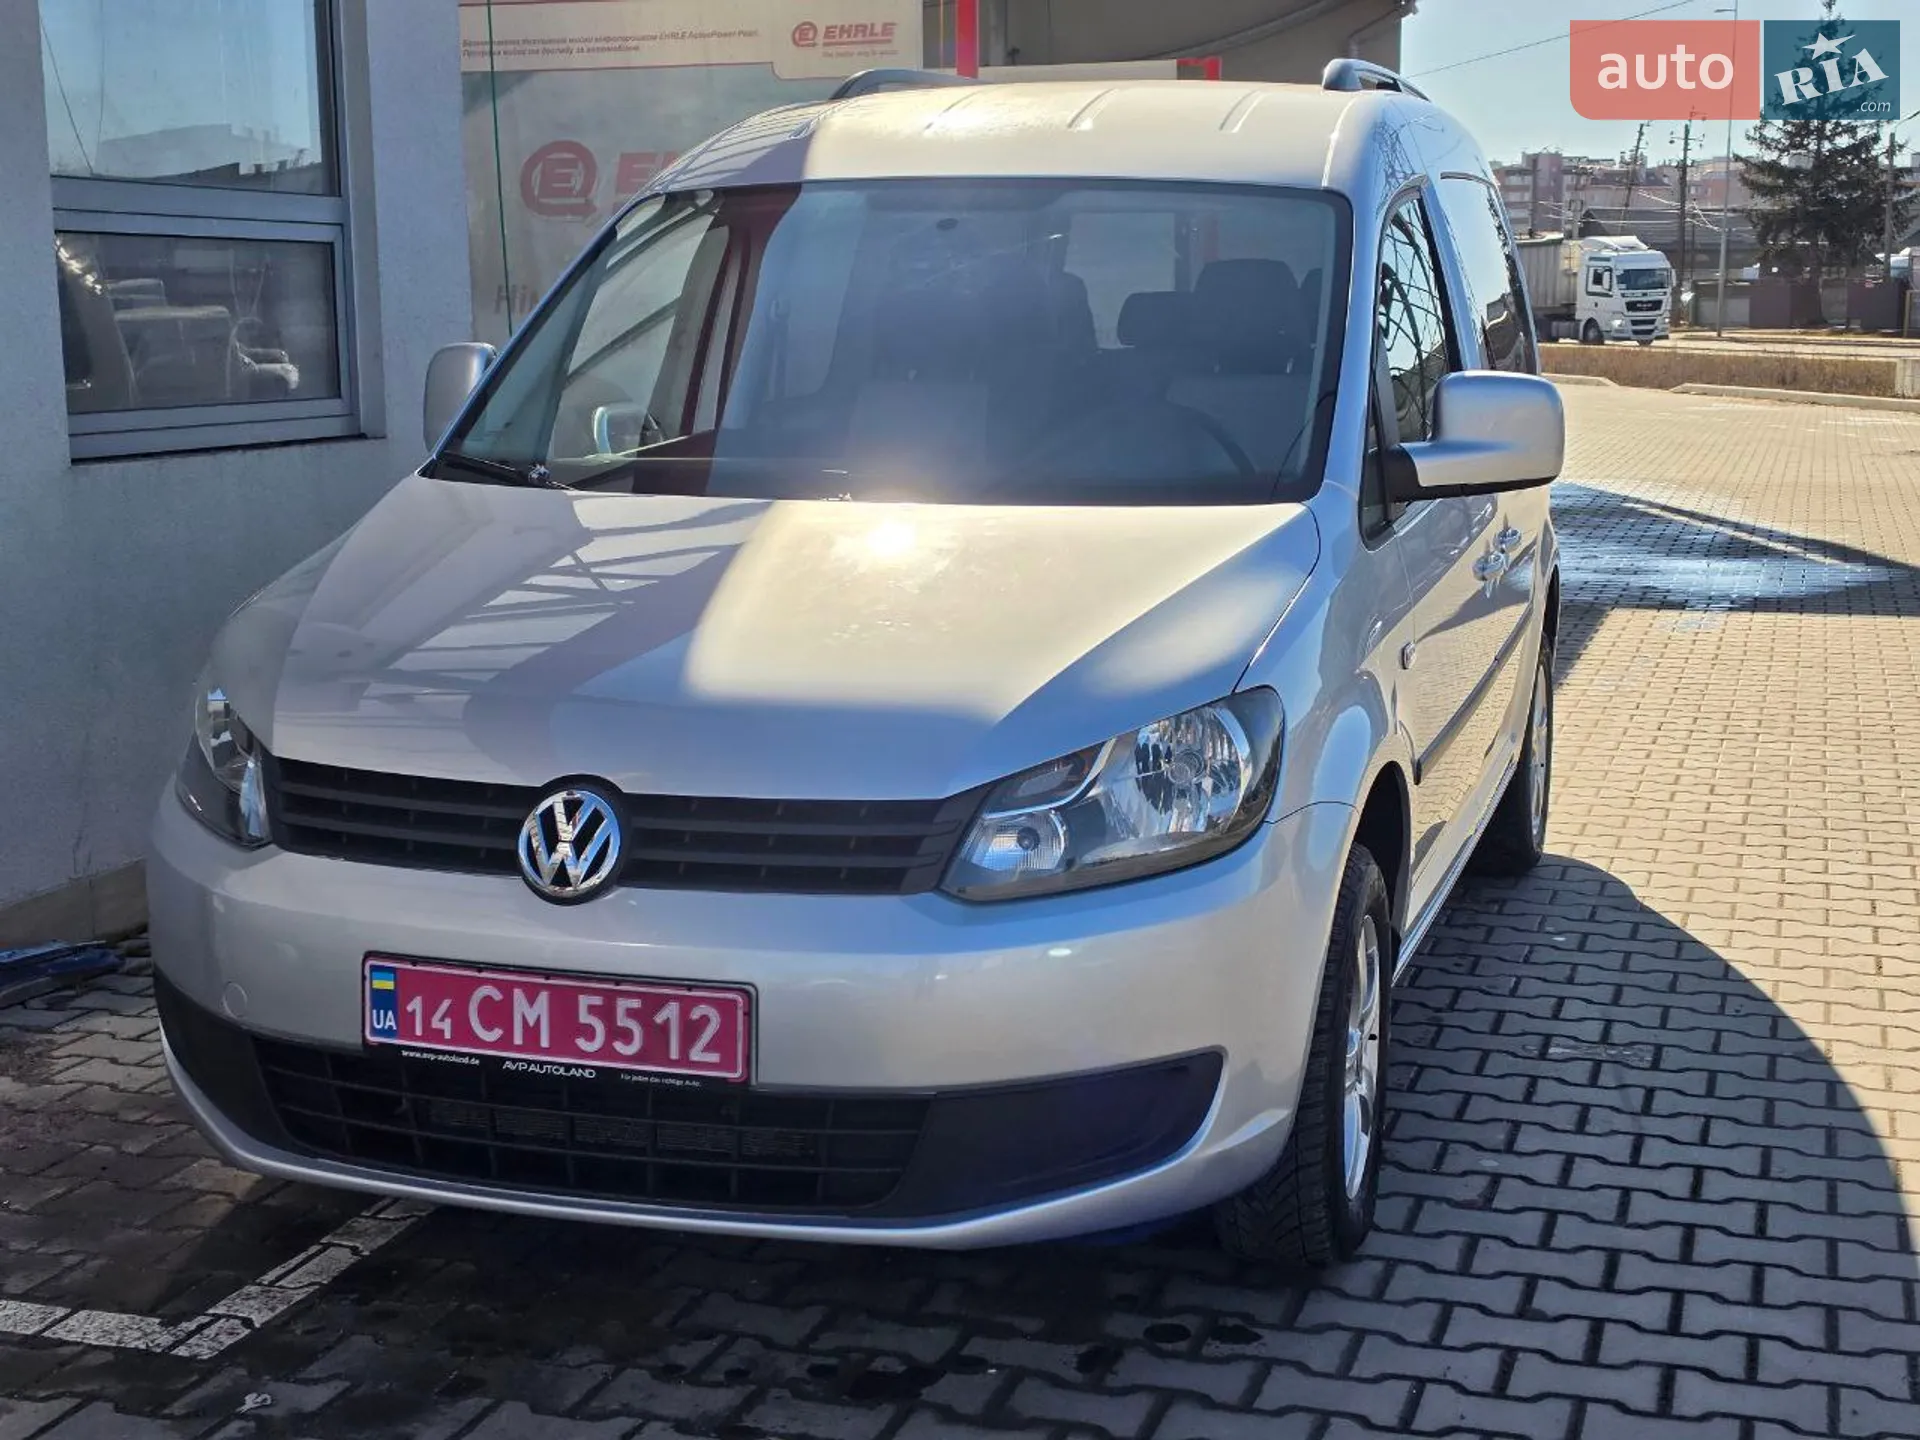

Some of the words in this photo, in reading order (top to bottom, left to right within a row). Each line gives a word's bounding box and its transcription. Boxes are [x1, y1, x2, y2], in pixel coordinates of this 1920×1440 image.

[823, 22, 897, 40] EHRLE
[372, 1009, 397, 1031] UA
[406, 995, 452, 1039] 14
[468, 985, 550, 1048] CM
[575, 994, 721, 1063] 5512
